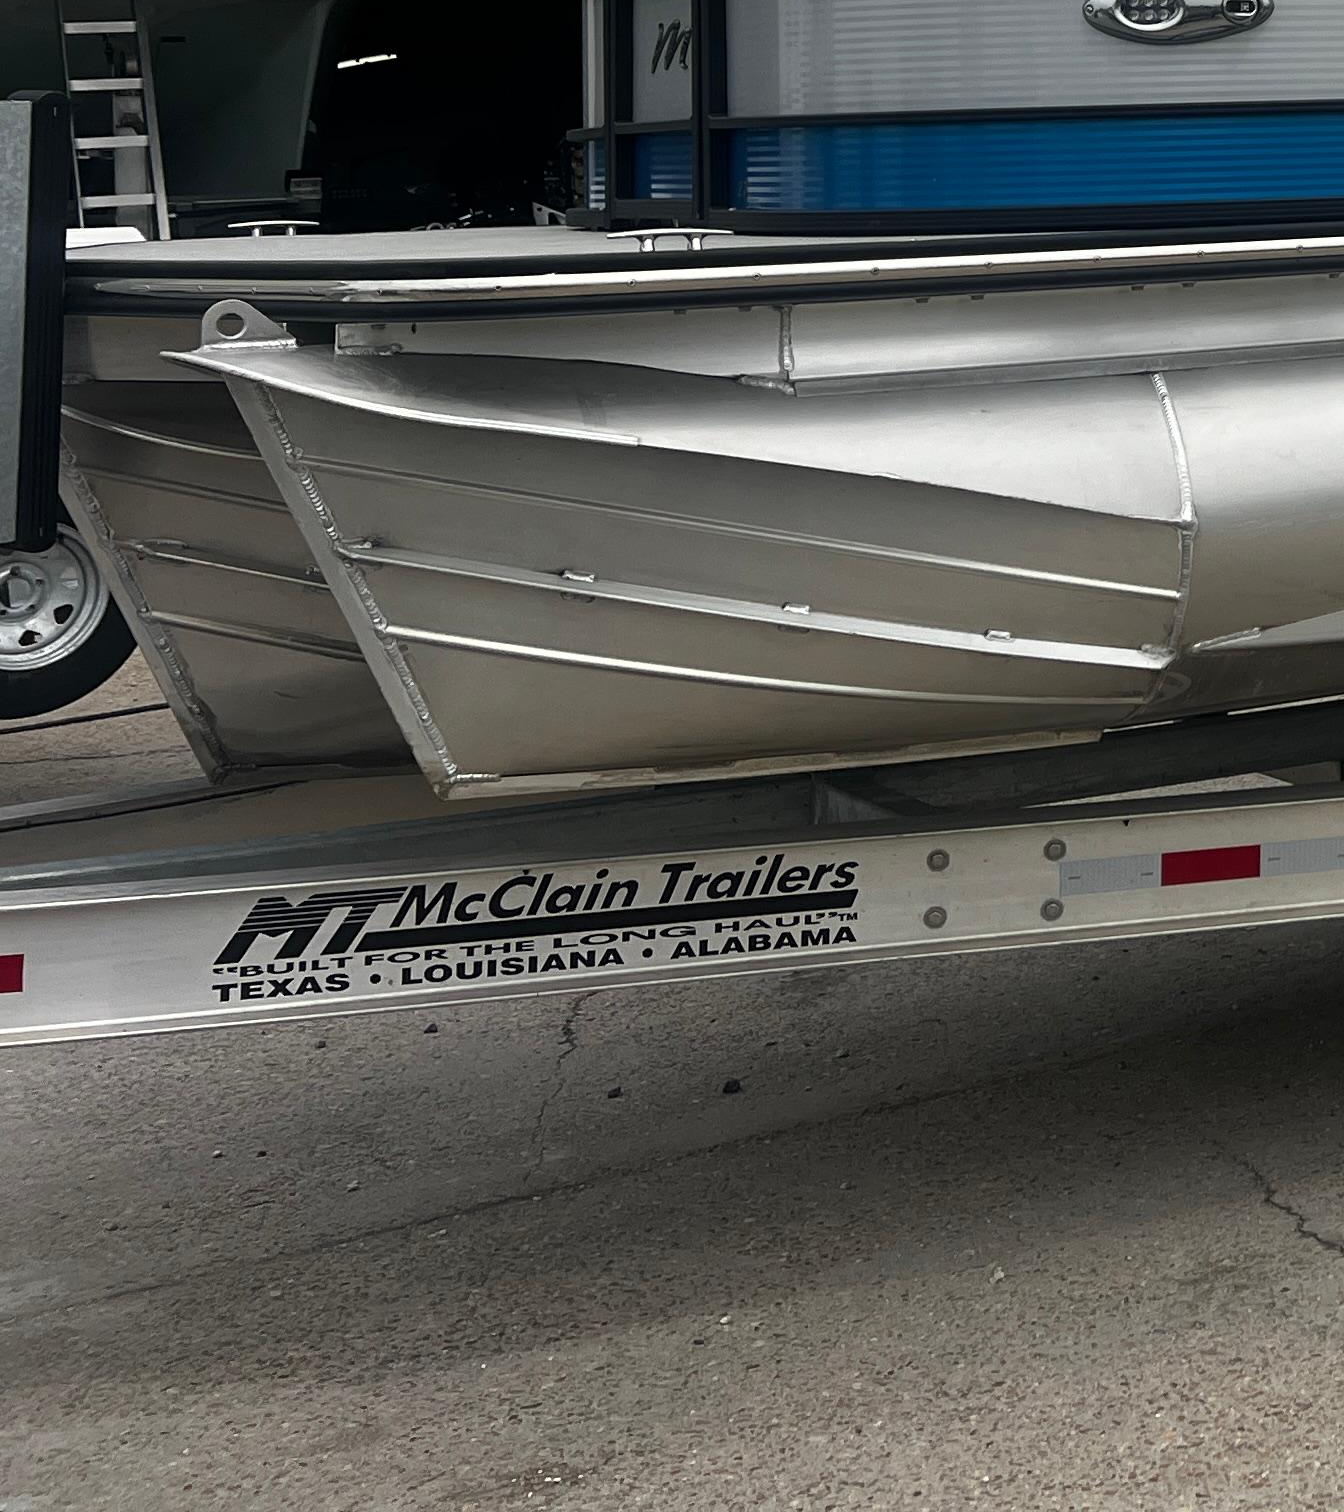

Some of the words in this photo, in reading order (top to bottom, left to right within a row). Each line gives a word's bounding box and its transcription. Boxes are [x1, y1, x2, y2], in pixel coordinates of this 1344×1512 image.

[389, 868, 639, 928] McClain
[658, 854, 860, 904] Trailers
[212, 972, 351, 1003] TEXAS
[401, 947, 625, 985] LOUISIANA
[670, 926, 857, 959] ALABAMA
[363, 948, 448, 967] FOR
[459, 940, 536, 957] THE
[552, 926, 697, 949] LONG
